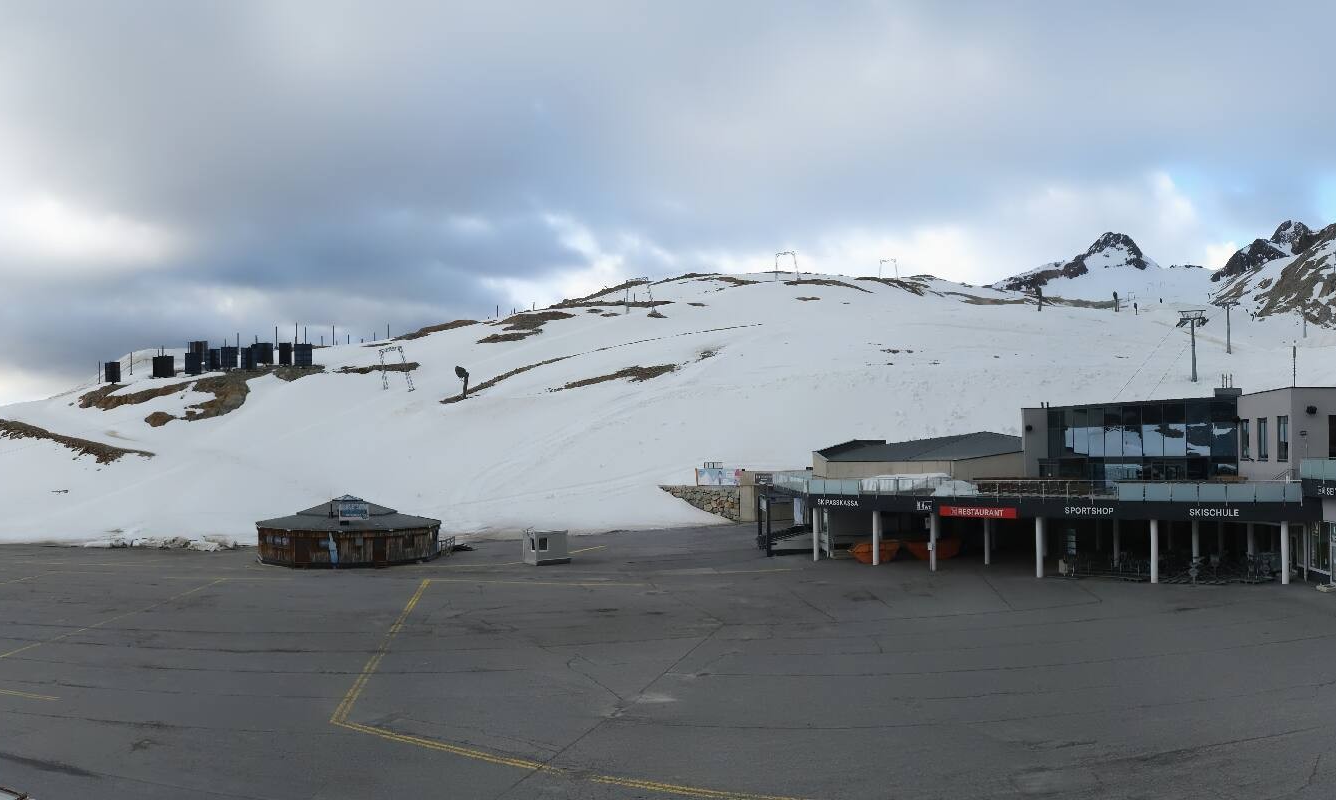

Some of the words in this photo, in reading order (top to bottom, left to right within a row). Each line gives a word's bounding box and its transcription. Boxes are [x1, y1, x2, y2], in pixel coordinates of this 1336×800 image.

[958, 508, 1004, 517] RESTAURANT
[1064, 506, 1114, 515] SPORTSHOP
[1189, 508, 1240, 517] SKISCHULE
